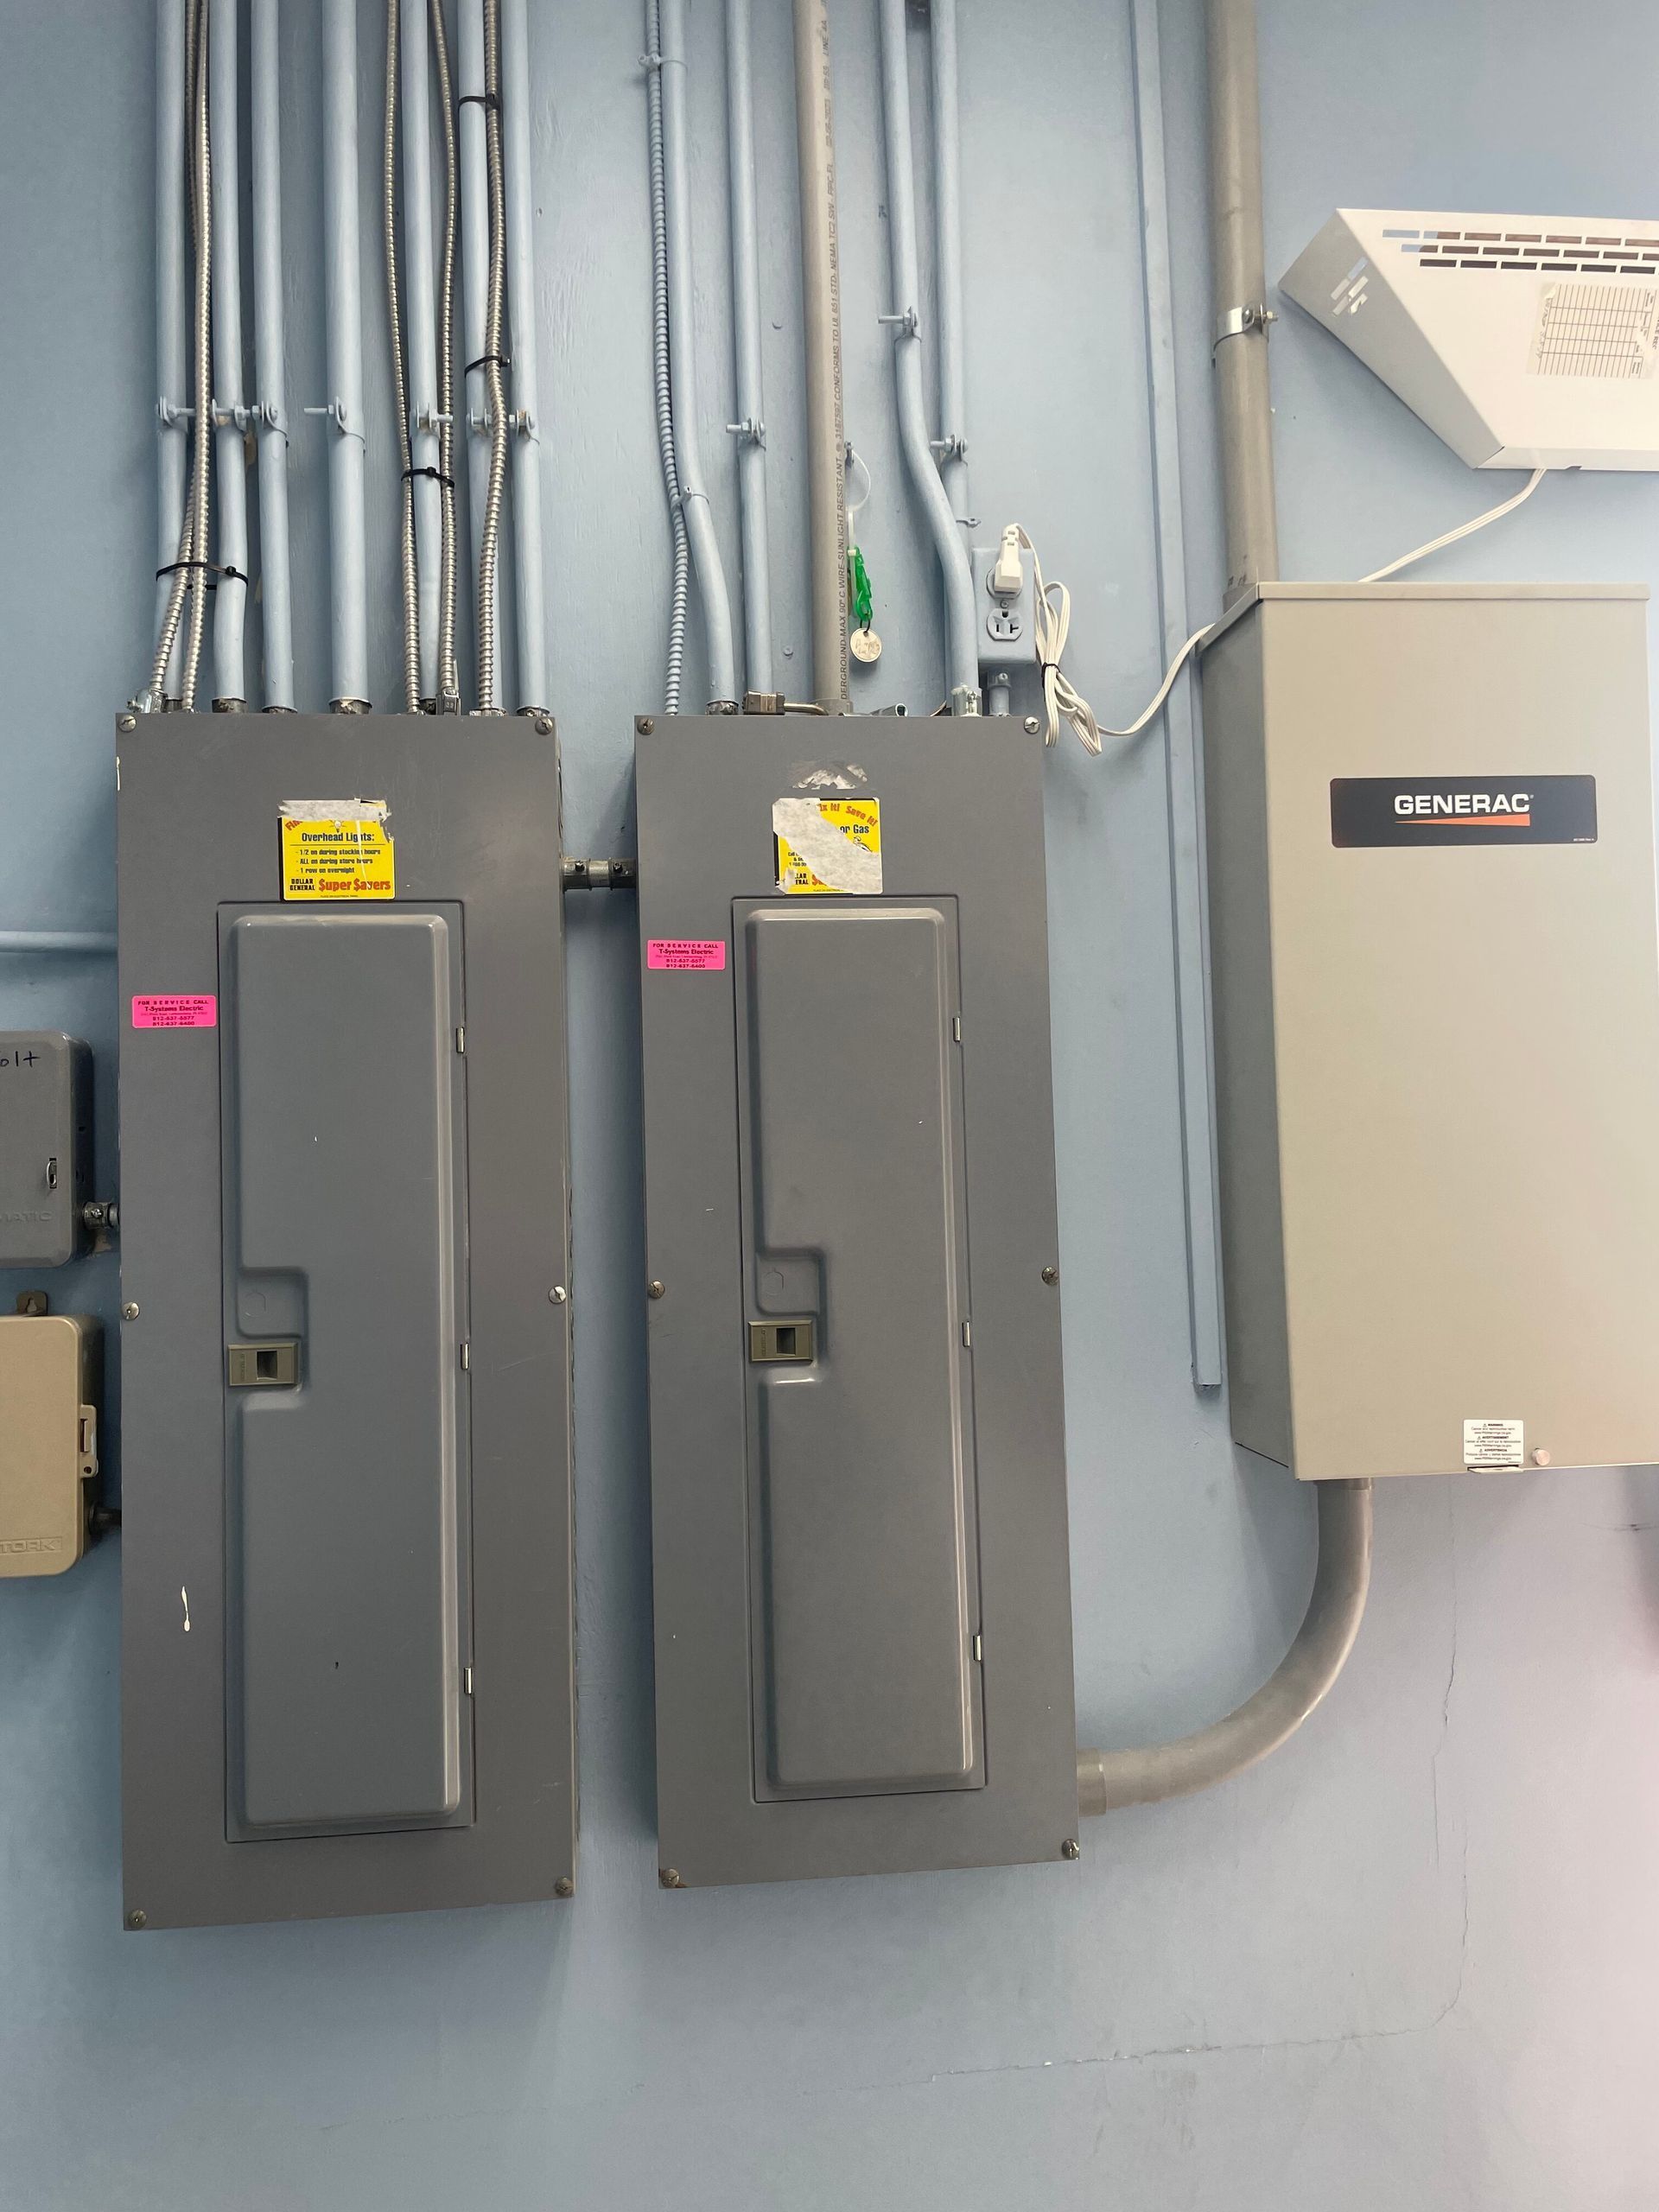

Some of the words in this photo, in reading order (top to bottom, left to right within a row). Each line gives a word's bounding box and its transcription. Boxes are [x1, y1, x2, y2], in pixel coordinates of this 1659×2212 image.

[832, 316, 838, 326] UL
[832, 328, 839, 341] TO
[1395, 793, 1530, 815] GENERAC
[846, 805, 866, 820] Save
[854, 823, 869, 834] Gas
[302, 833, 343, 842] Overhead
[0, 1051, 41, 1068] olt
[0, 1540, 55, 1554] TORK
